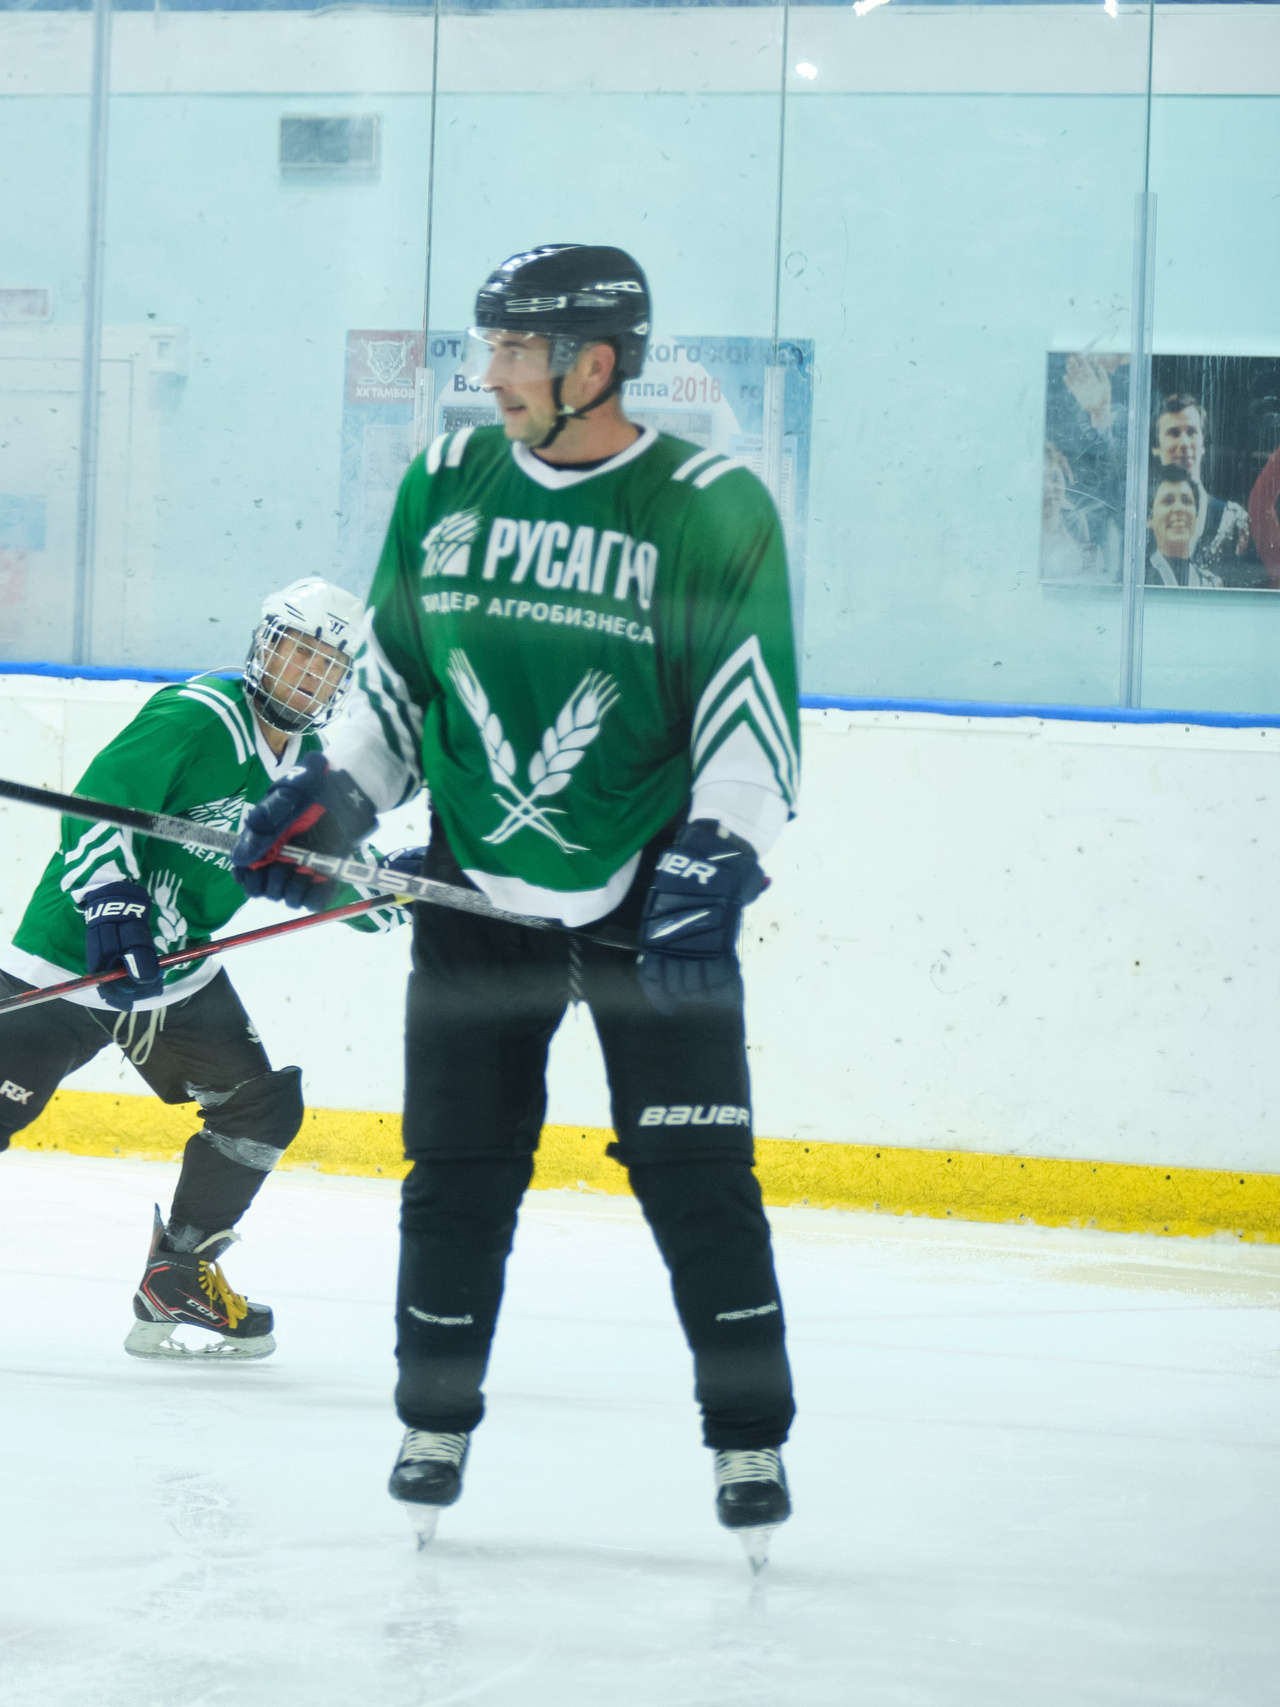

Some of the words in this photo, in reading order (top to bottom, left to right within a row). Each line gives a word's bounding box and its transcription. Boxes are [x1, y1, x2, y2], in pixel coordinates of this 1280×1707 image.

[671, 376, 723, 404] 2016
[486, 597, 656, 645] АГРОБИЗНЕСА
[181, 842, 216, 863] ДЕР
[639, 1105, 750, 1127] BAUER
[186, 1298, 220, 1321] CCM
